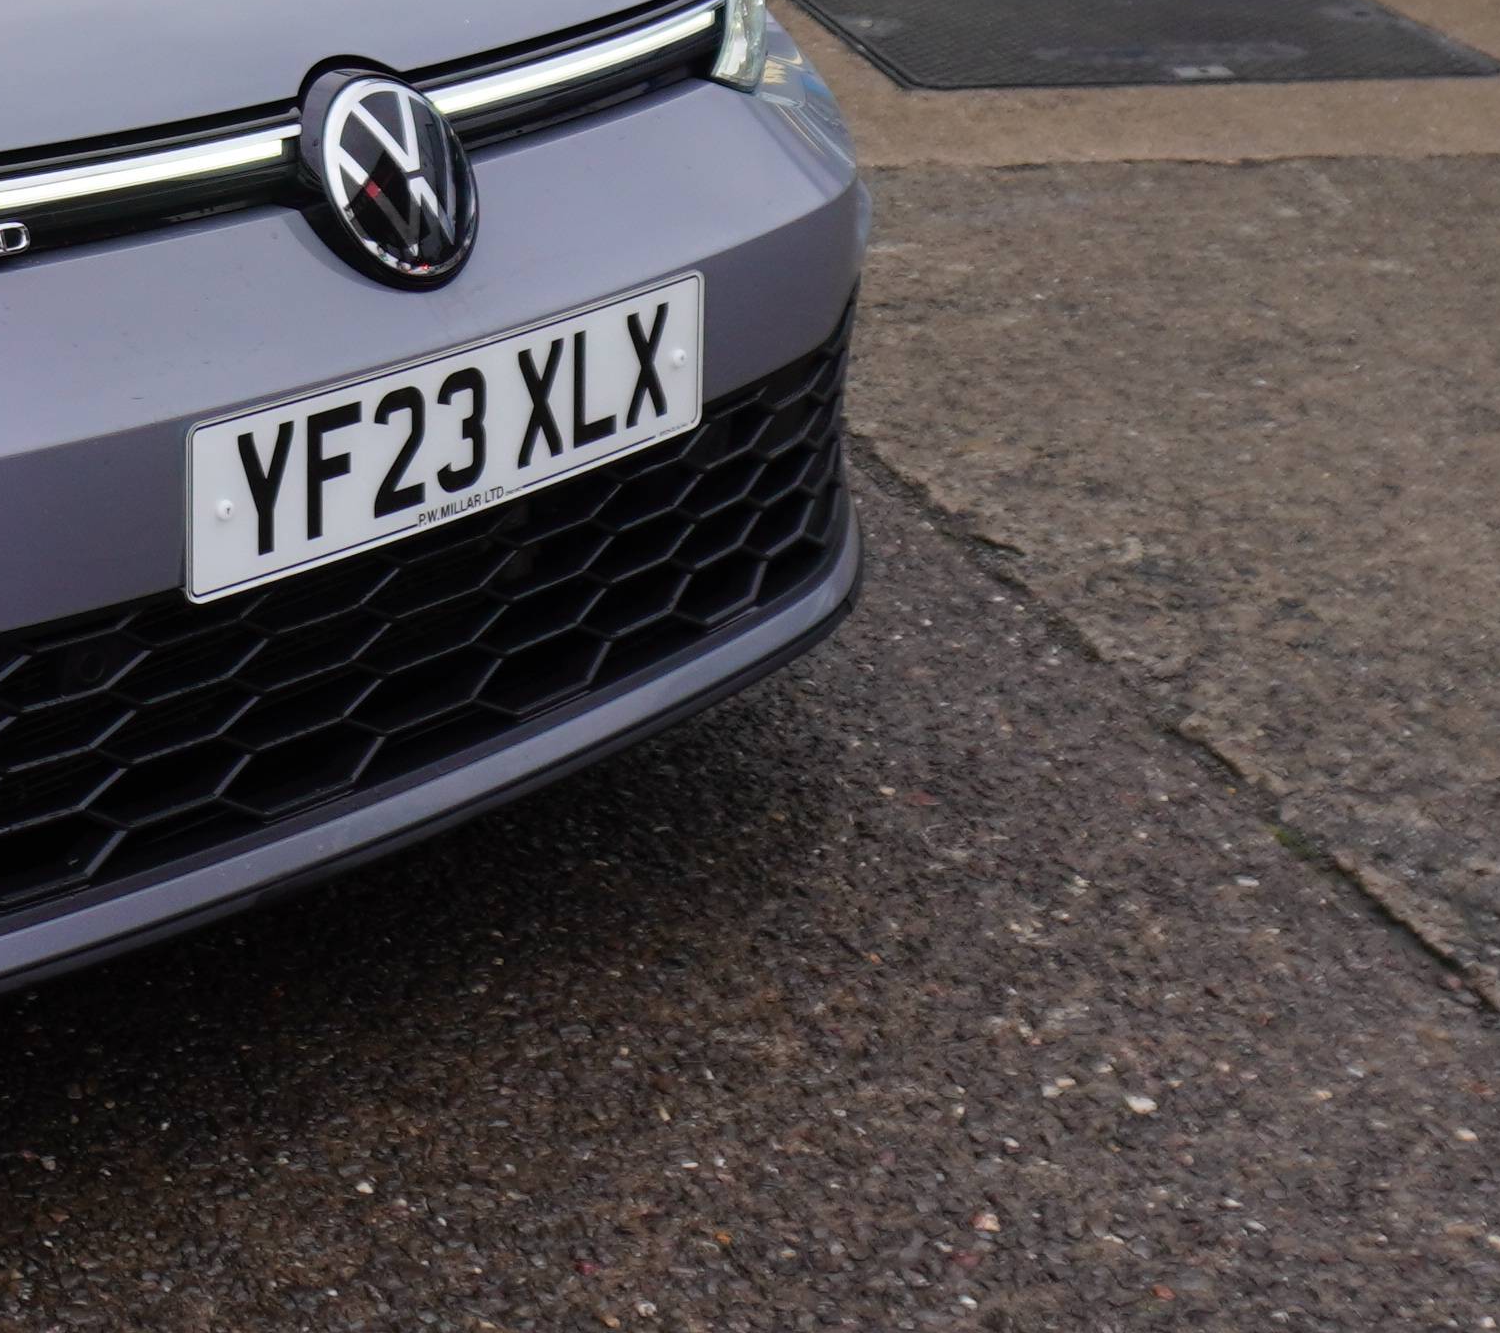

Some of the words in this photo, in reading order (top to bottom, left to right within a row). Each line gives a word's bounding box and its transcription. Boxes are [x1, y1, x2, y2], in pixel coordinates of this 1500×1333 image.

[237, 367, 487, 556] YF23
[517, 302, 669, 470] XLX
[418, 494, 482, 527] P.W.MILLAR
[485, 486, 504, 504] LTD
